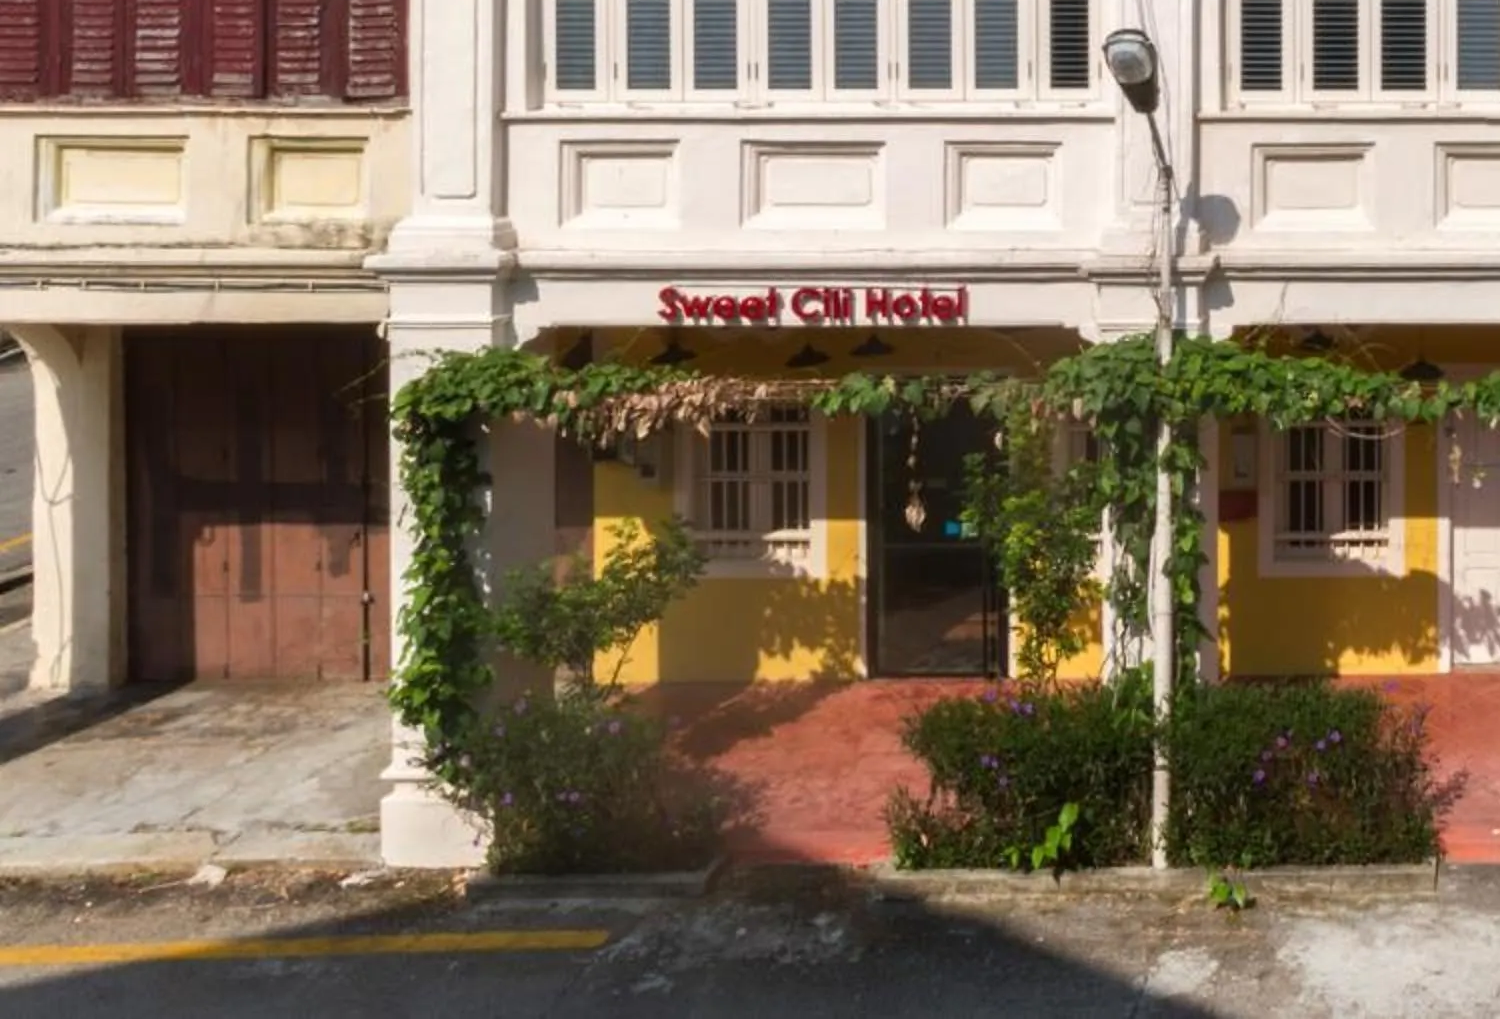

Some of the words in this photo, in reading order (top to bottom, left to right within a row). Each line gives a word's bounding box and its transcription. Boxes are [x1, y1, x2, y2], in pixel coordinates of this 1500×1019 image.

[657, 286, 779, 321] Sweet
[791, 286, 851, 320] Cili
[864, 285, 967, 320] Hotel
